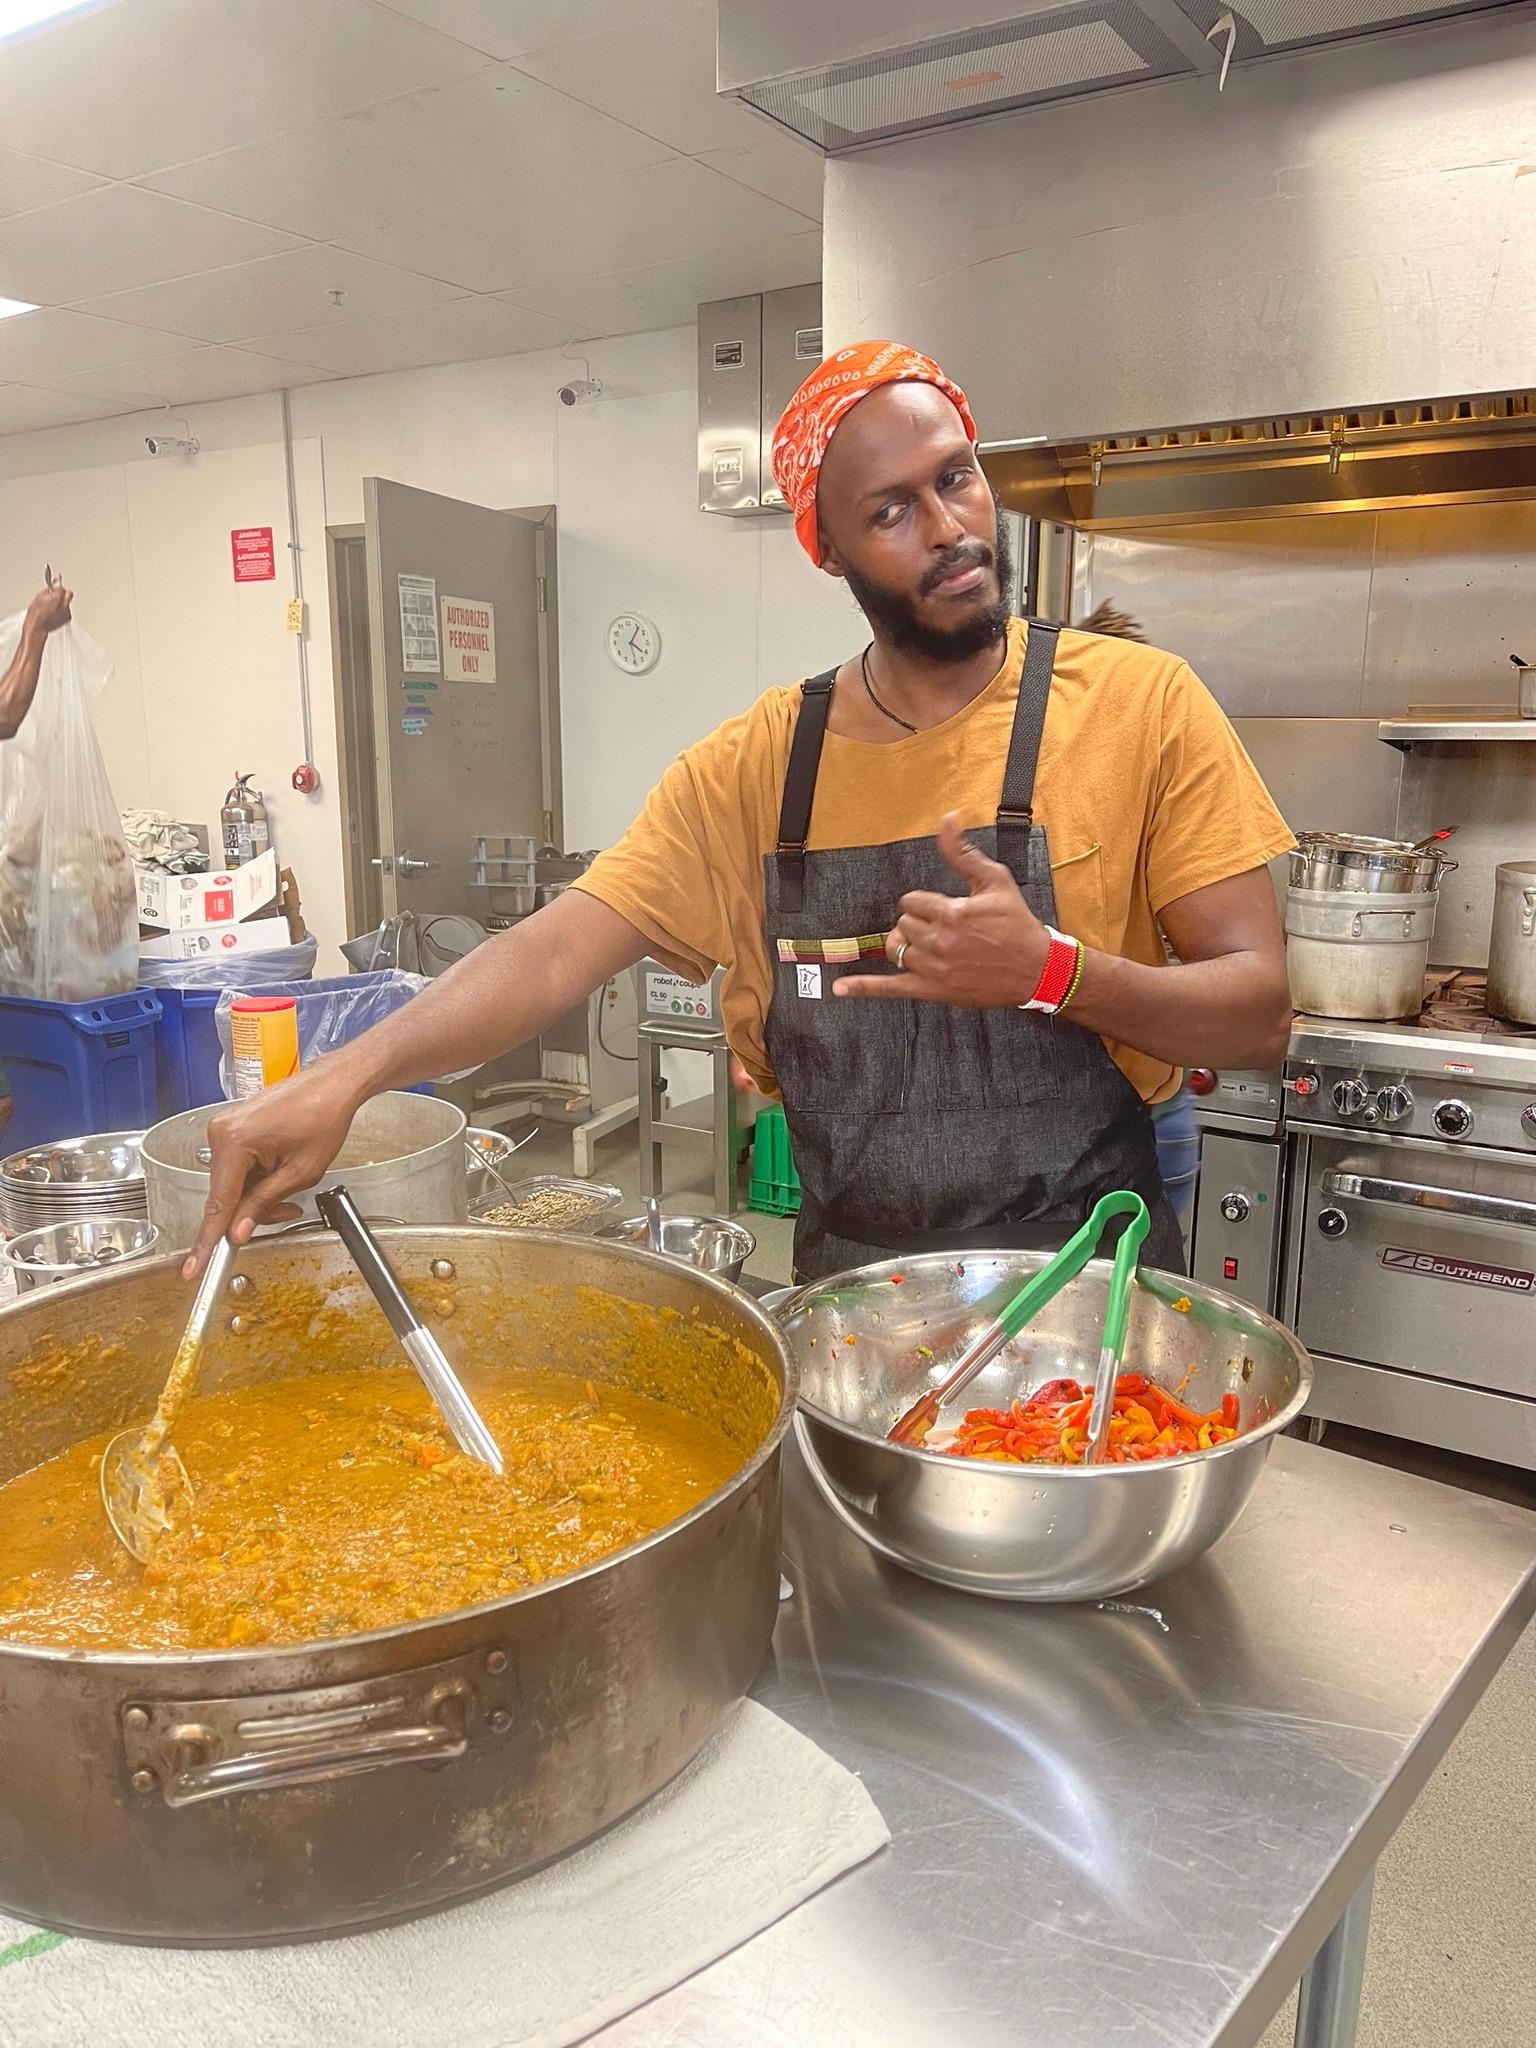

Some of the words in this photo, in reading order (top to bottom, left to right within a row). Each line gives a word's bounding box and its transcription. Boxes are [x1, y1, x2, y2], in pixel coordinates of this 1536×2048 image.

[447, 606, 489, 629] AUTHORIZED
[449, 630, 489, 651] PERSONNEL
[462, 655, 479, 673] ONLY
[490, 918, 509, 926] TITAN
[654, 977, 673, 985] robot
[1415, 1255, 1530, 1288] SOUTHBEND
